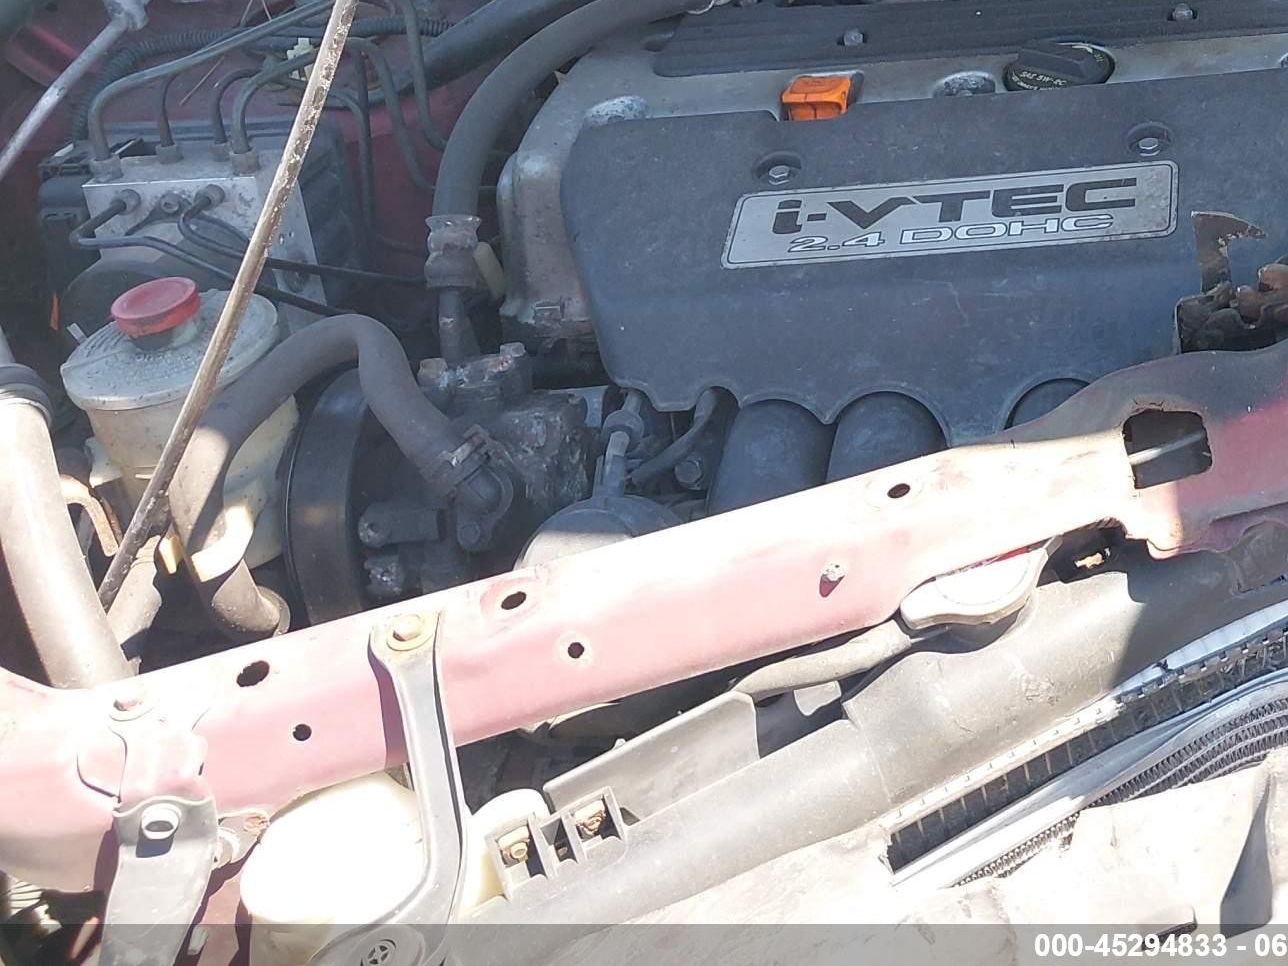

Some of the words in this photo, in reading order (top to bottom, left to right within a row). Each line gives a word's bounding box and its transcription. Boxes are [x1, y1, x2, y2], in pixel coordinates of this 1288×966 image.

[773, 178, 1137, 234] i-VTEC
[787, 231, 885, 253] 2.4
[899, 214, 1114, 244] DOHC
